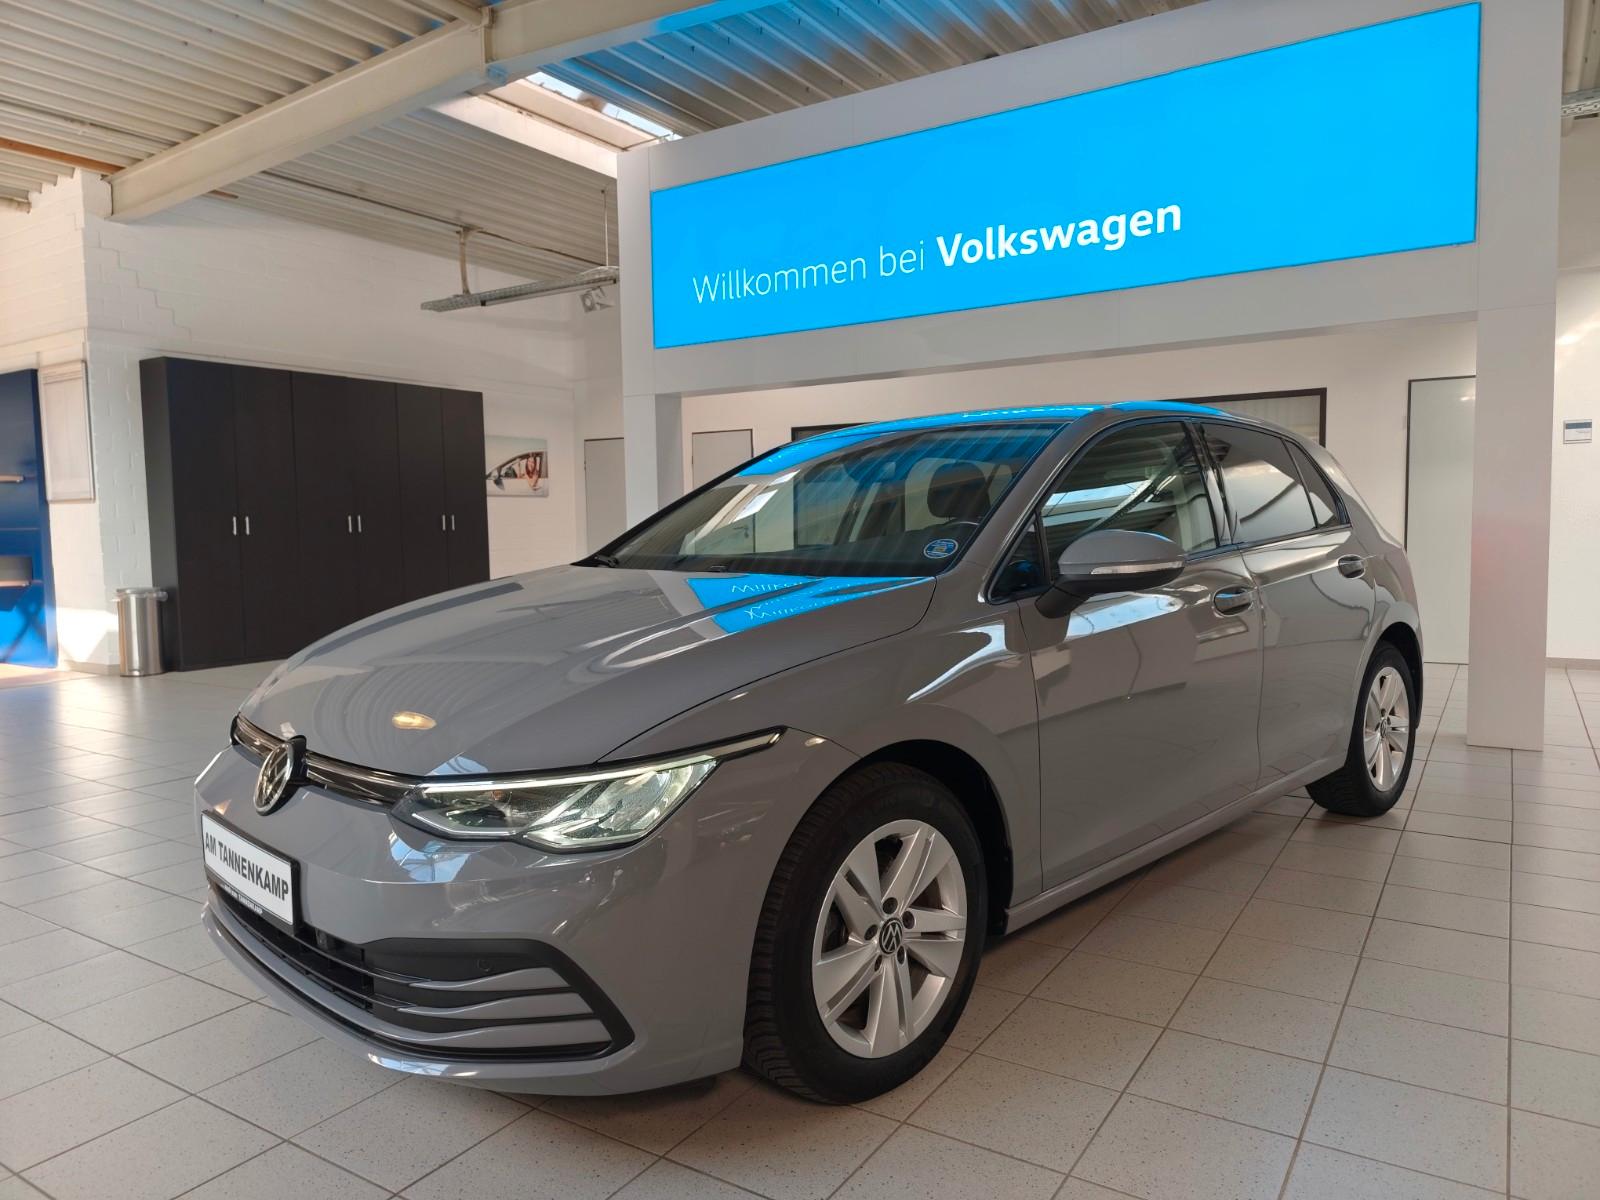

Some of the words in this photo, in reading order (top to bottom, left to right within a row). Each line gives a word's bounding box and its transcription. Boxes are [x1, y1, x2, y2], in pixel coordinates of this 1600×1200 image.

[692, 256, 867, 304] Willkommen
[878, 240, 925, 277] bei
[936, 204, 1182, 267] Volkswagen
[205, 832, 217, 857] AM
[218, 843, 289, 901] TANNENKAMP
